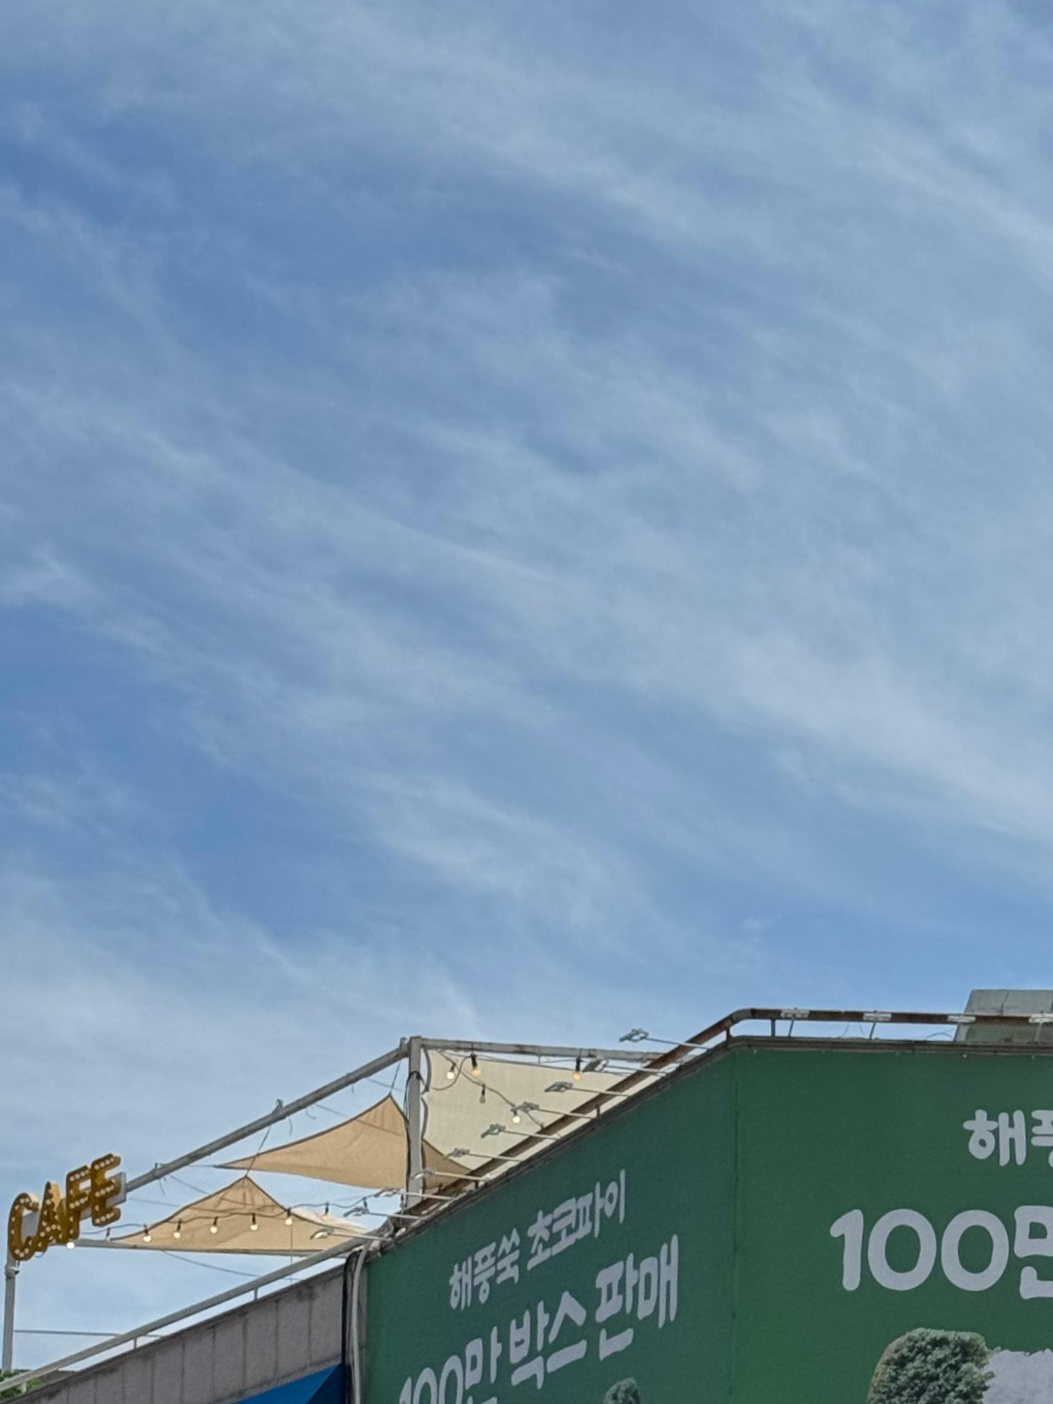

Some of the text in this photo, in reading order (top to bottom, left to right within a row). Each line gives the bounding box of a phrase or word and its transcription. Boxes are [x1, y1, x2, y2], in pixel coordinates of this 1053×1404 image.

[7, 1152, 122, 1262] CAFE
[448, 1169, 626, 1311] 해풍쑥 초코파이
[509, 1291, 587, 1390] 박스
[596, 1234, 679, 1361] 판매
